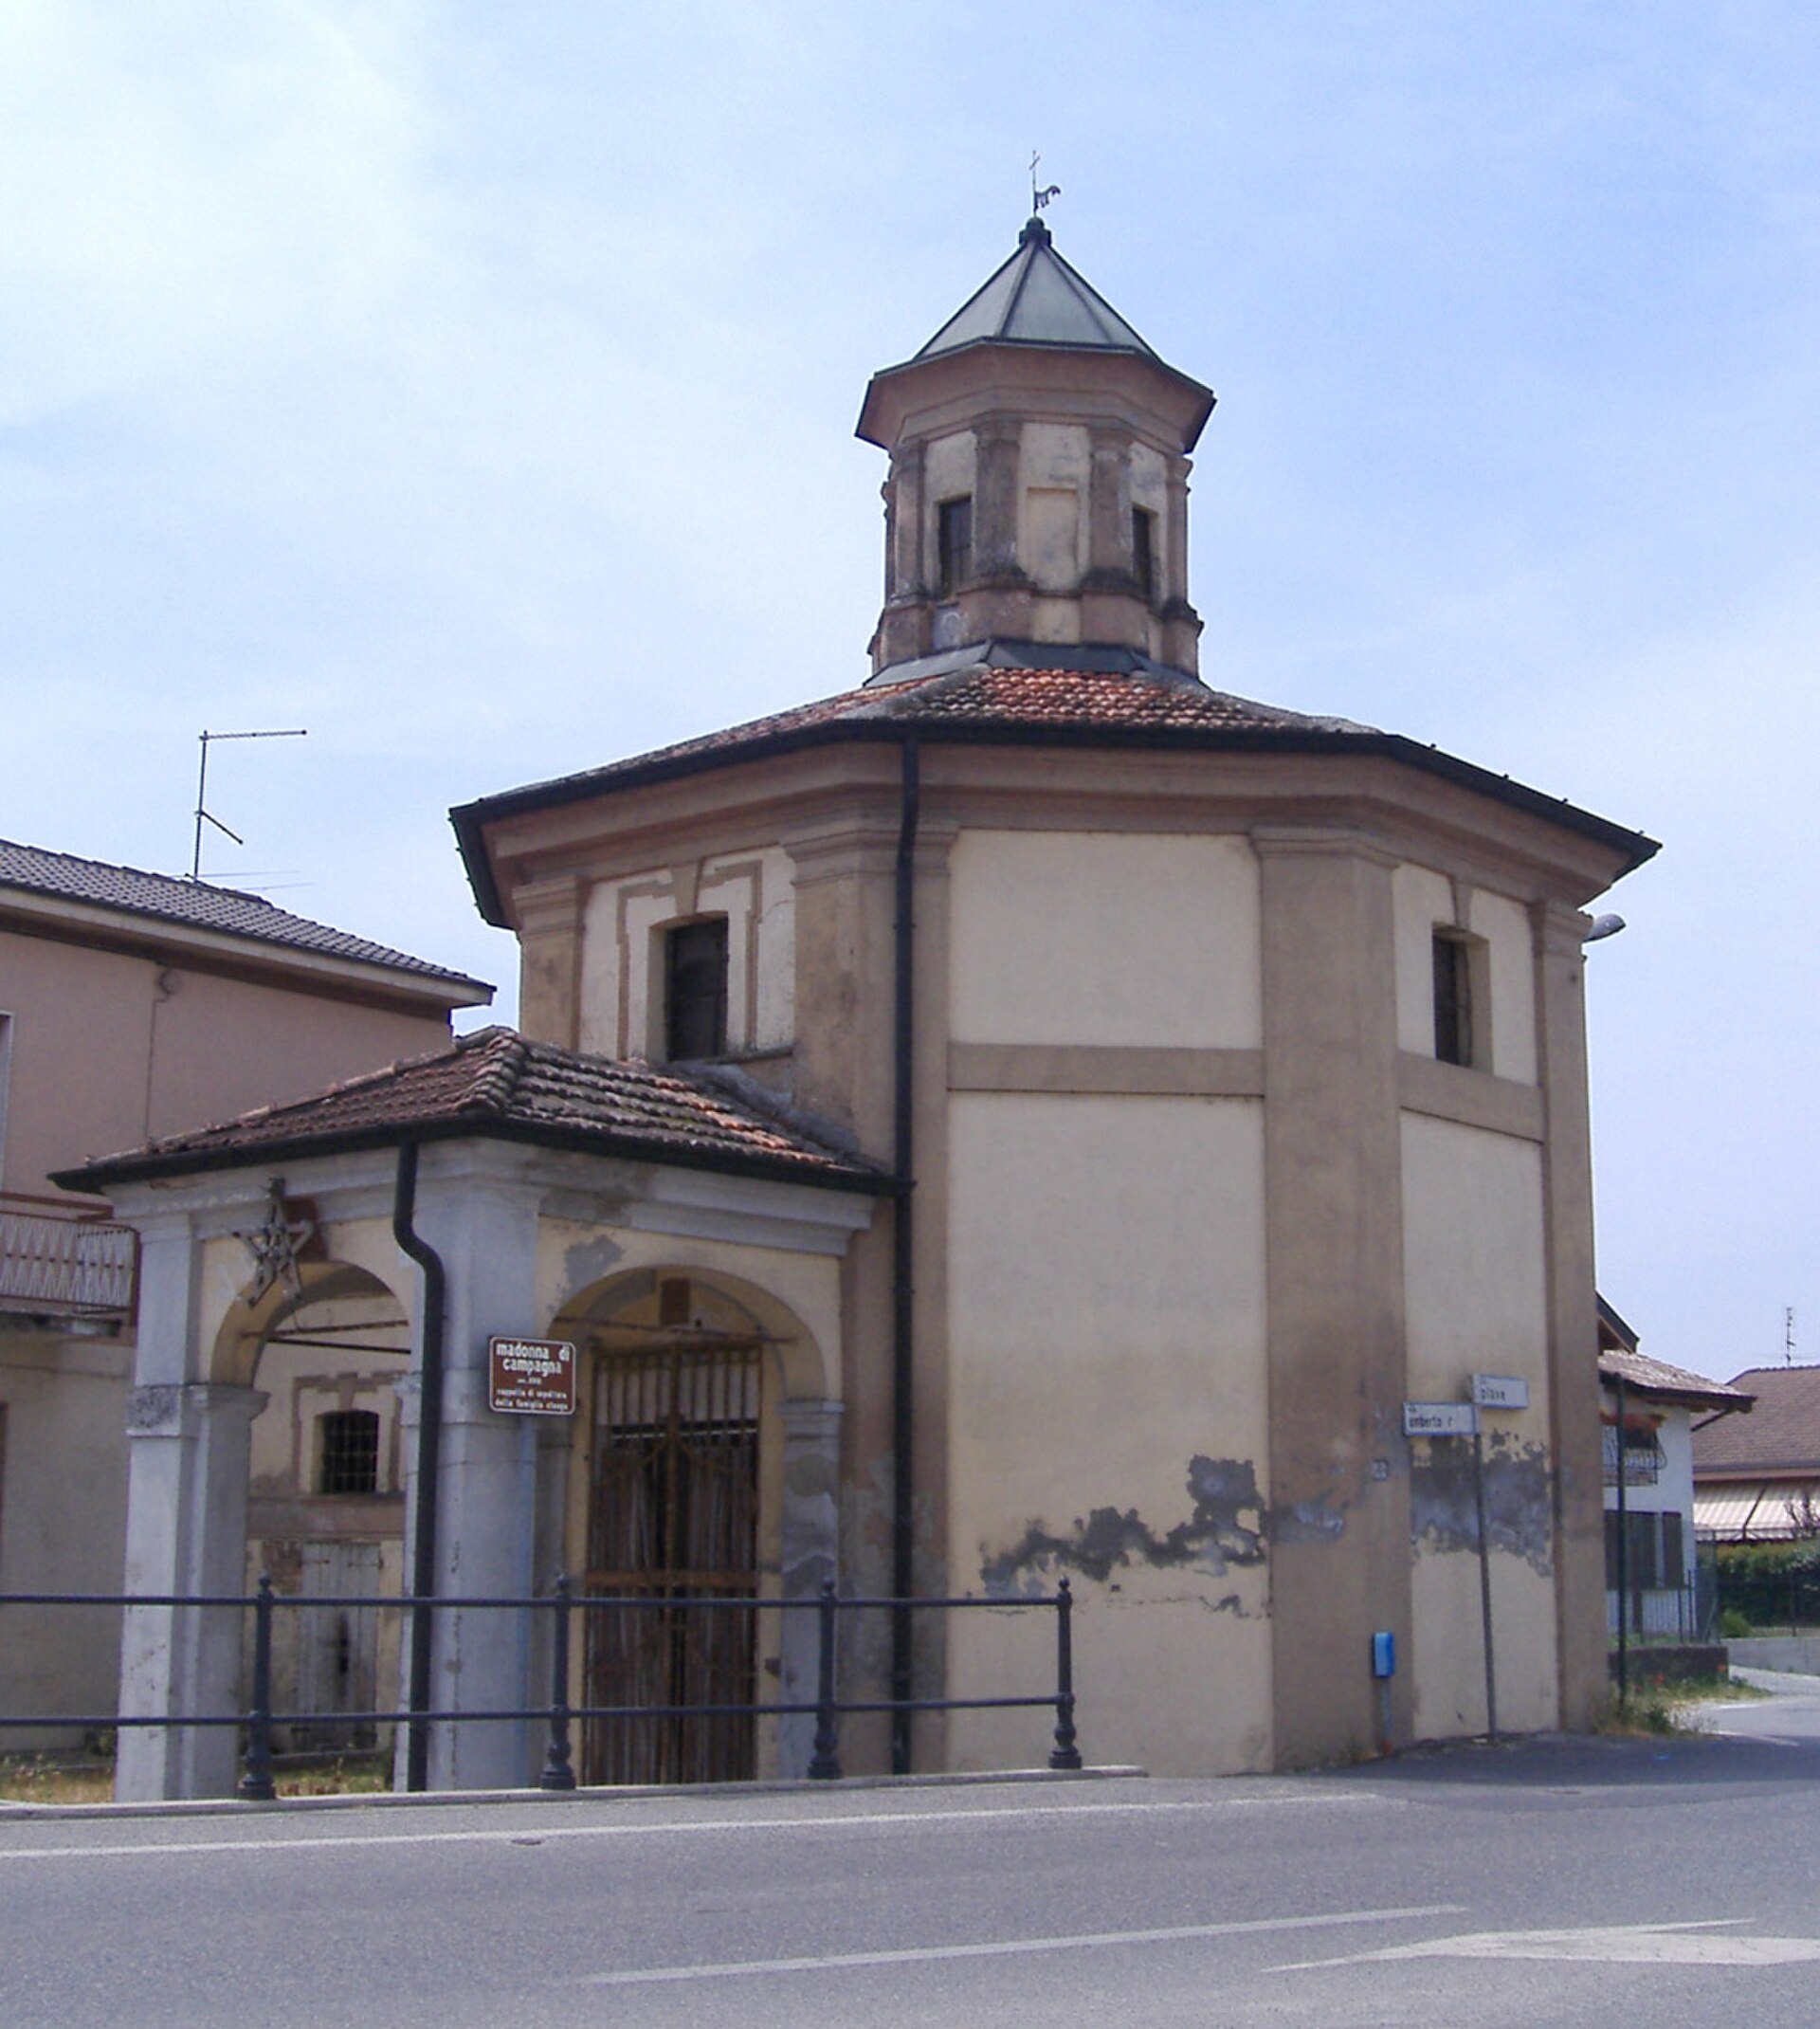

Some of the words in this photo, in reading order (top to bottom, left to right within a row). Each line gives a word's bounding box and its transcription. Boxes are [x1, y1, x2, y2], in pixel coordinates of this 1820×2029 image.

[497, 1343, 549, 1360] madonna
[558, 1344, 570, 1362] di
[502, 1358, 562, 1377] campagna
